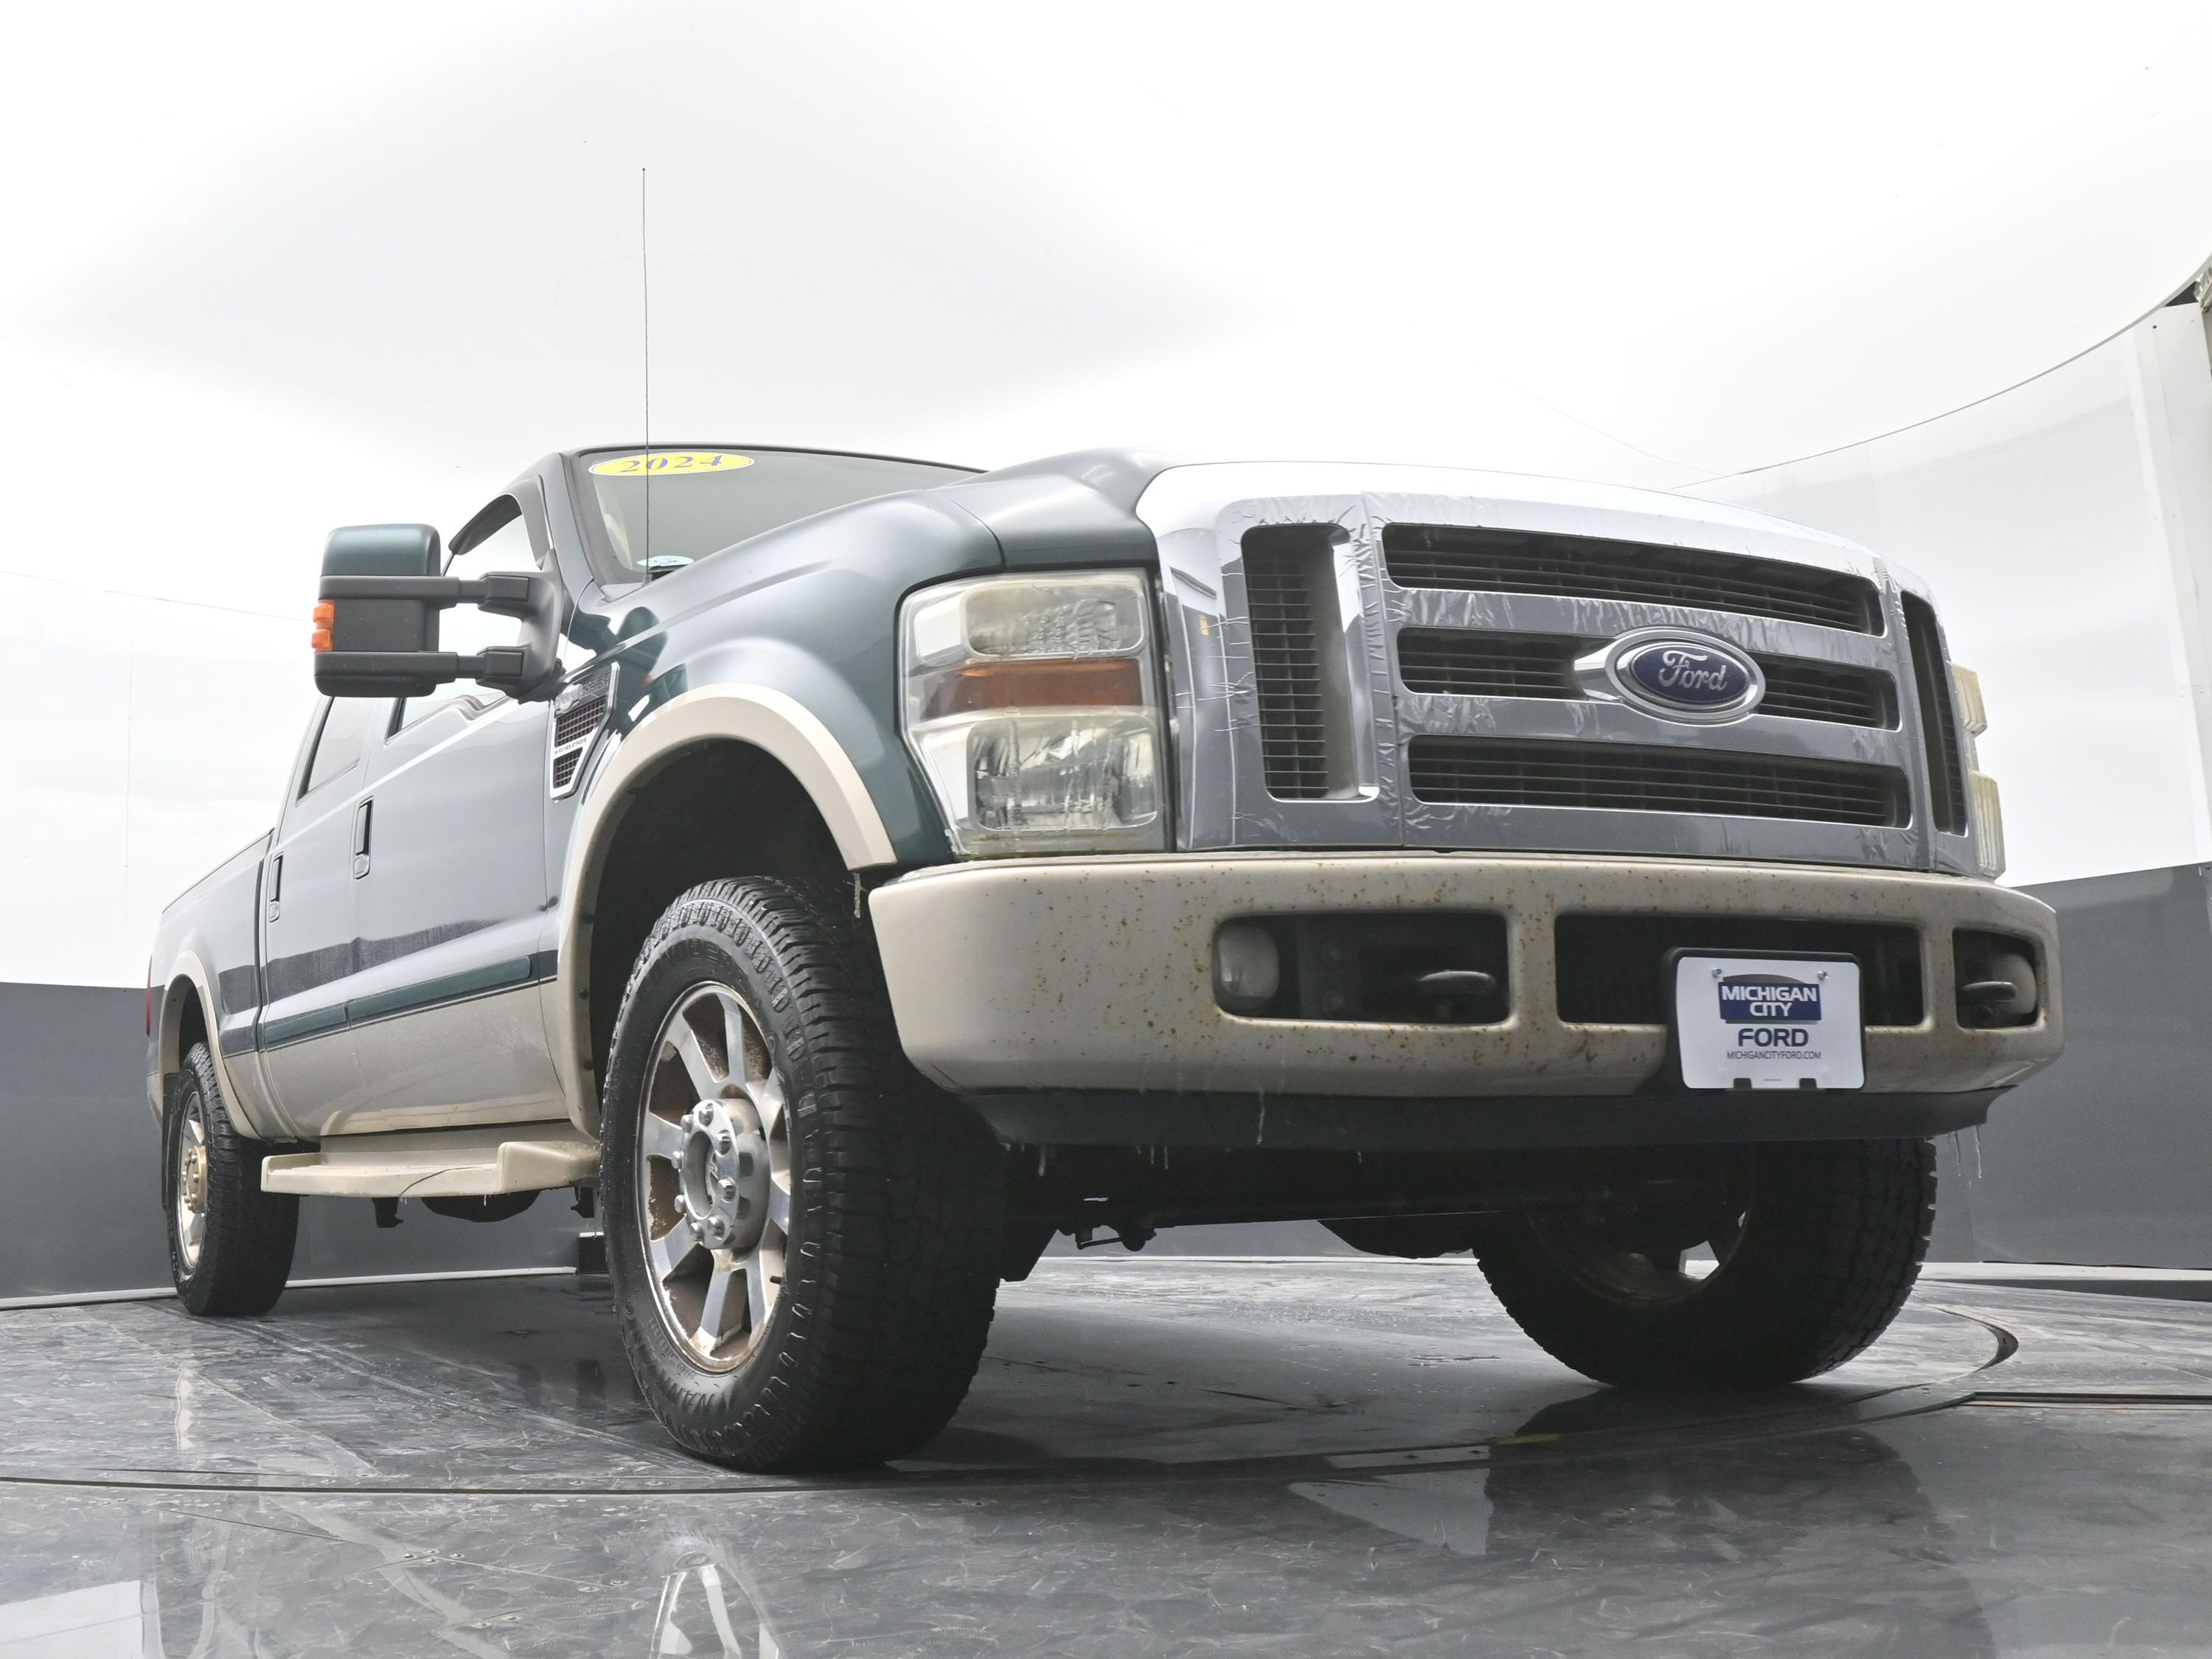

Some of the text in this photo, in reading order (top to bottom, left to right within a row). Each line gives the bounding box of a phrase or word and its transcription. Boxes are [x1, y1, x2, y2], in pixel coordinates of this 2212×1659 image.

[619, 454, 723, 473] 2024
[1658, 650, 1728, 692] Ford
[1721, 985, 1818, 1002] MICHIGAN
[1749, 1001, 1793, 1018] CITY
[1737, 1027, 1809, 1048] FORD
[1726, 1050, 1822, 1060] MICHIGANCITYFORD.COM
